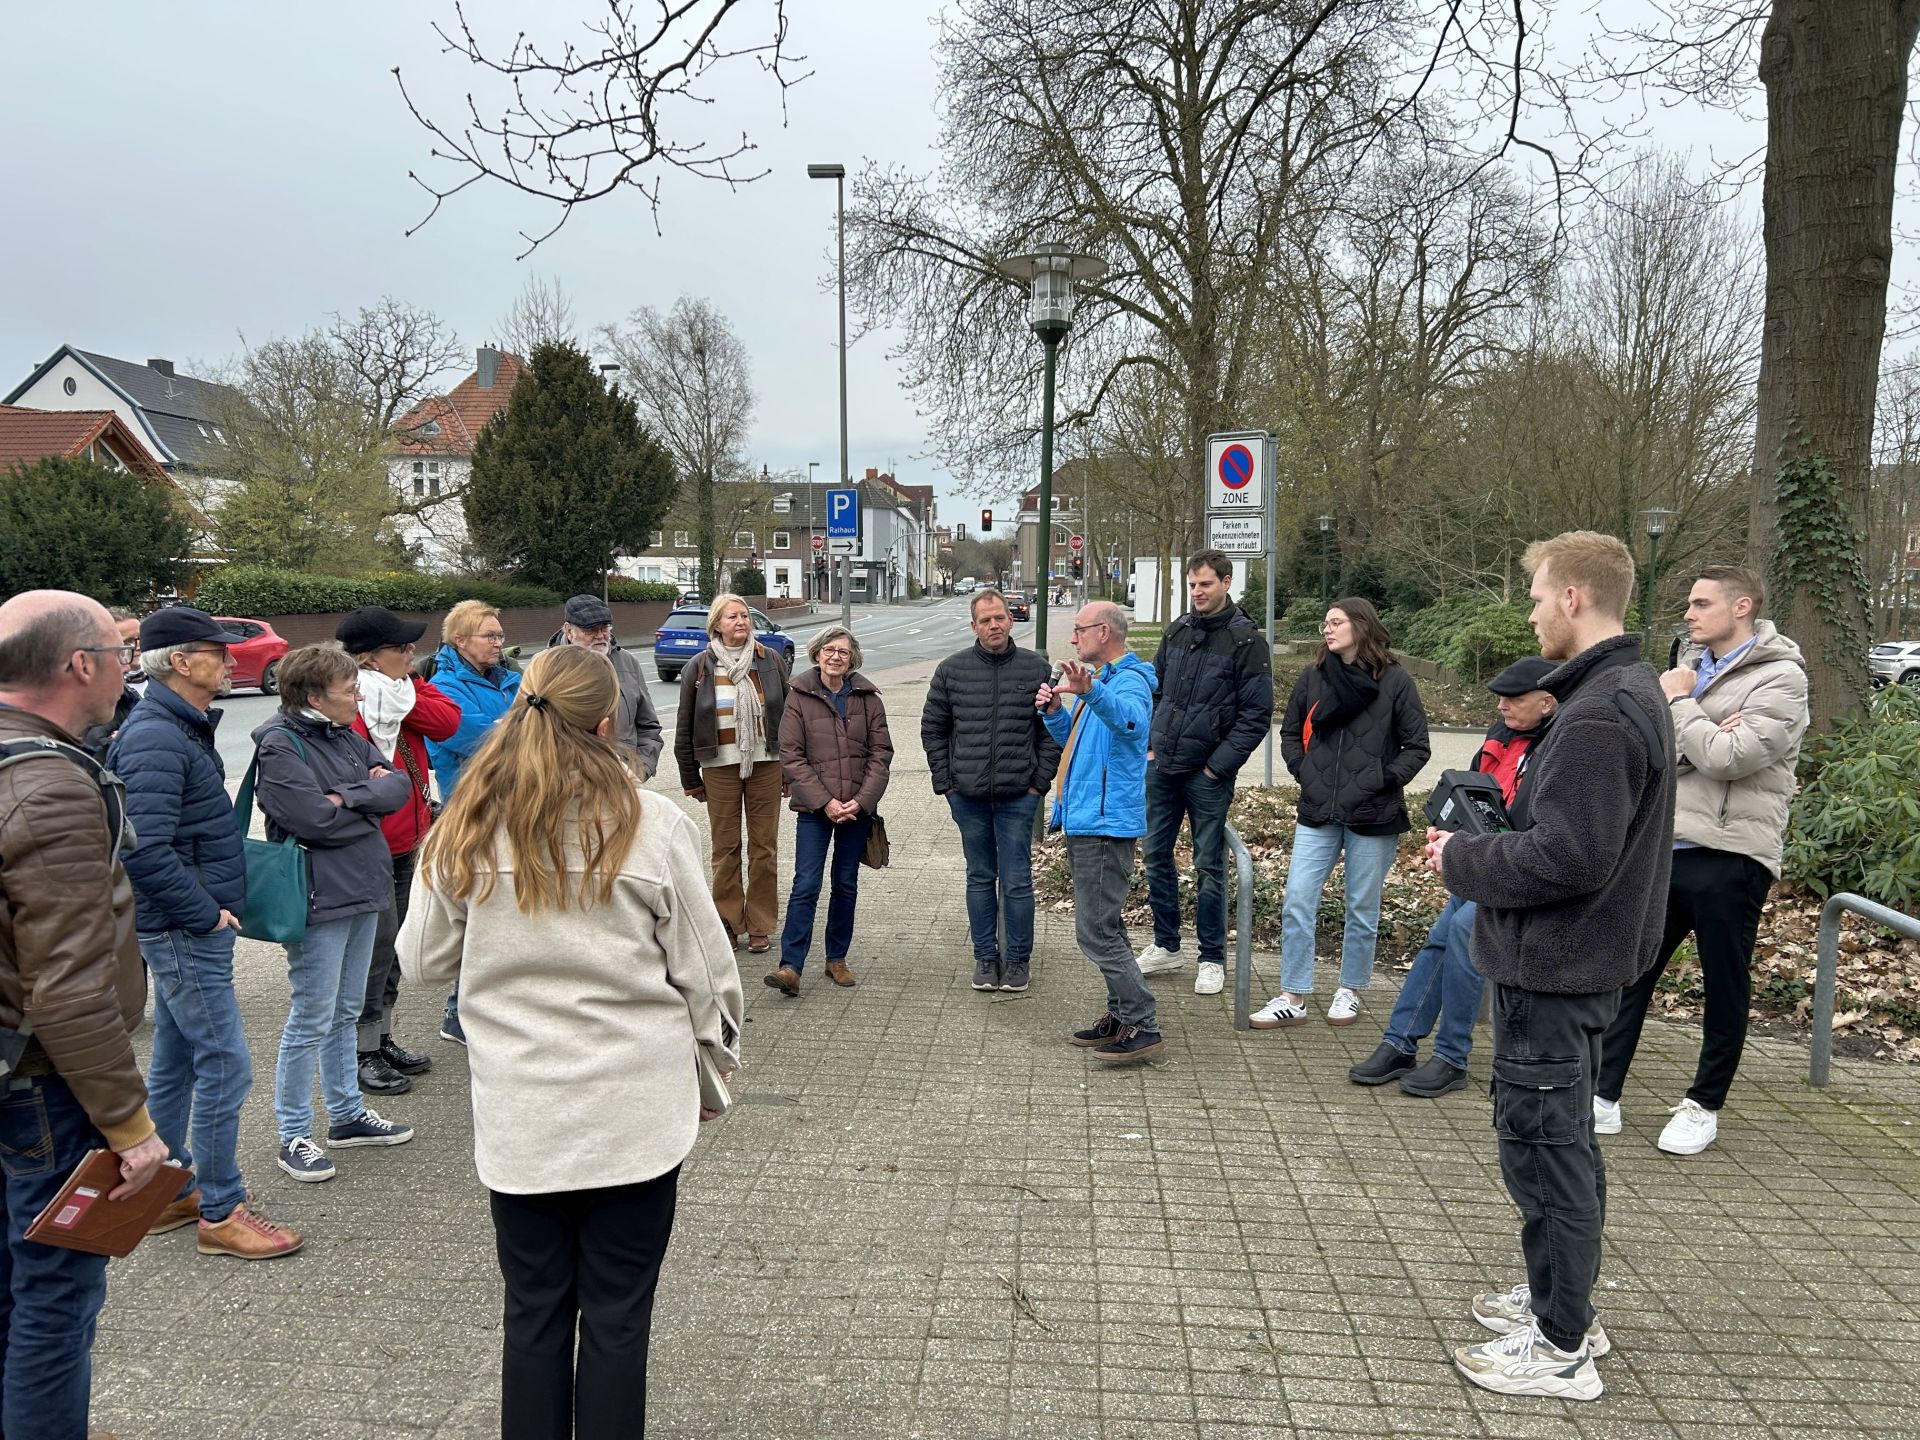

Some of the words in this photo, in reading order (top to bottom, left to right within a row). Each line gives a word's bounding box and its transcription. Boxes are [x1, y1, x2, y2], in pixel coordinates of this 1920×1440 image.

[1222, 493, 1248, 504] ZONE
[834, 494, 850, 520] P
[1222, 521, 1241, 529] Parken
[1212, 532, 1260, 541] gekennzeichneten
